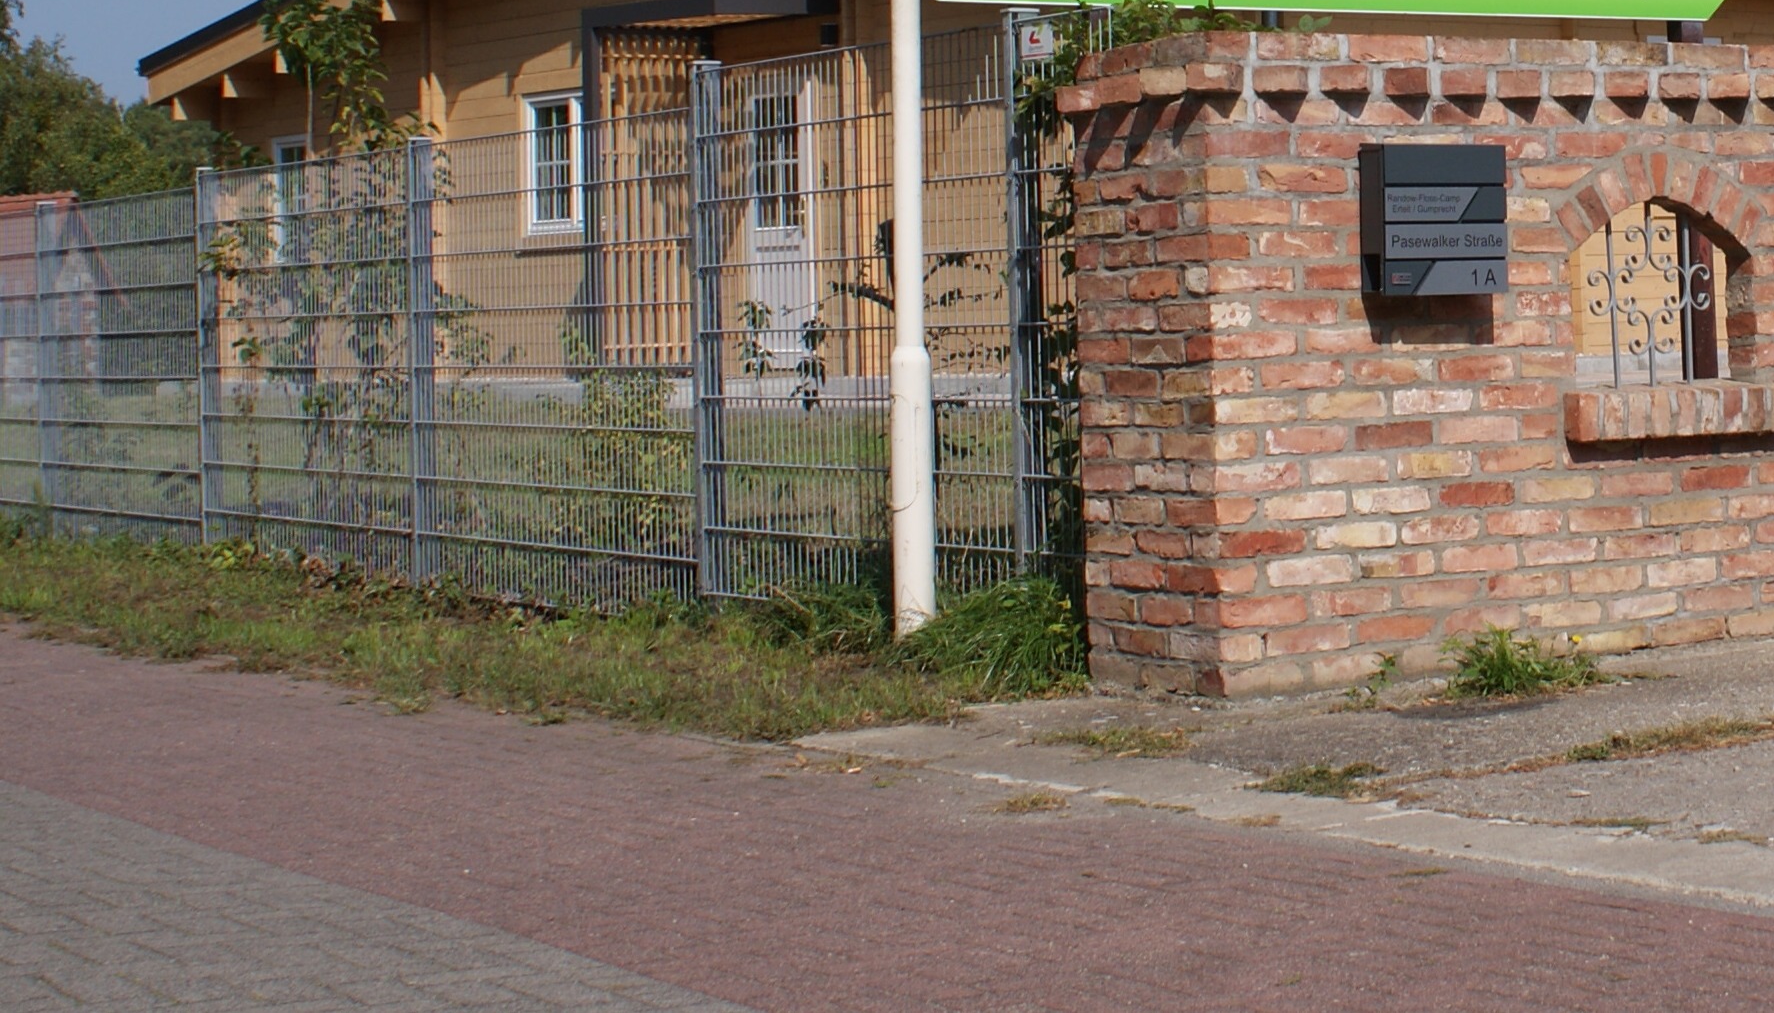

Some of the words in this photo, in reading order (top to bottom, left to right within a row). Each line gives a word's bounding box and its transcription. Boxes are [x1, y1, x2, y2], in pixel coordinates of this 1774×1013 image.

[1391, 234, 1460, 248] Pasewalker
[1464, 234, 1503, 248] Straße
[1471, 268, 1478, 286] 1
[1484, 268, 1497, 285] A
